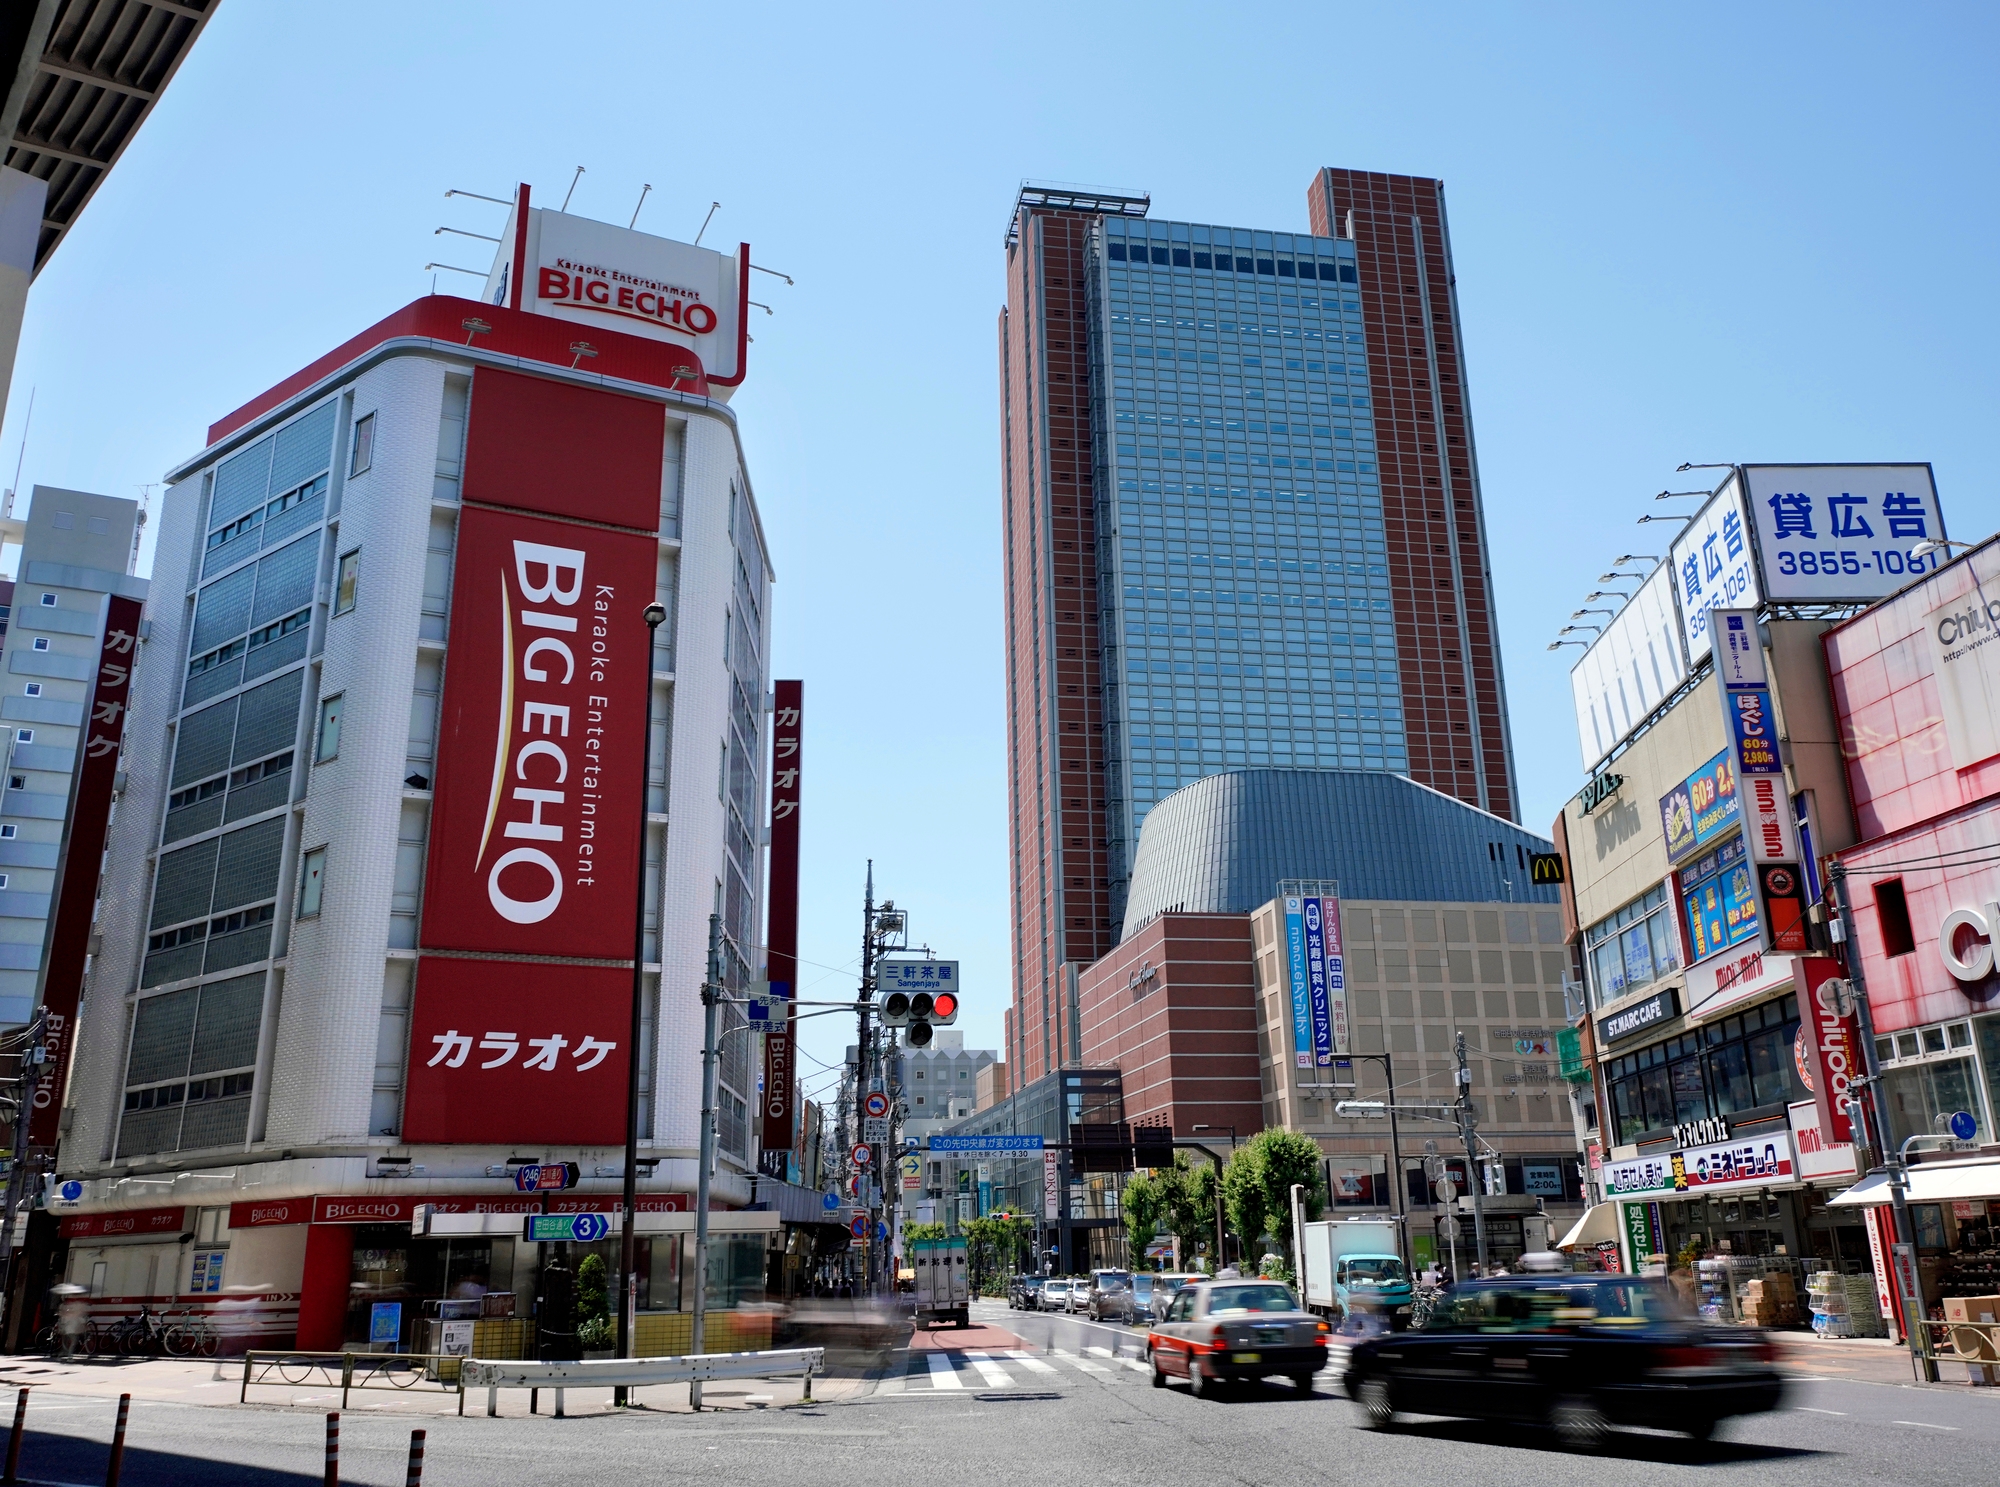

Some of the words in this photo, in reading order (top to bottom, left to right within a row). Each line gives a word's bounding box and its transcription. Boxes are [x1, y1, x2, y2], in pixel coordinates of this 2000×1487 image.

[557, 257, 607, 278] Karaoke
[612, 270, 700, 300] Entertainment
[538, 267, 609, 304] BIG
[617, 286, 717, 334] ECHO
[1768, 492, 1928, 541] 貸広告
[1682, 509, 1744, 606] 貸広告
[1778, 550, 1938, 575] 3855-1081
[512, 539, 585, 685] BIG
[588, 584, 614, 682] Karaoke
[87, 629, 135, 758] カラオケ
[1737, 694, 1764, 736] ほぐし
[1743, 738, 1769, 749] 60分
[1743, 751, 1774, 765] 2,980円
[773, 706, 800, 820] カラオケ
[576, 695, 608, 888] Entertainment
[1692, 778, 1714, 811] 60分
[1754, 779, 1776, 813] mini
[487, 702, 570, 924] ECHO
[1761, 823, 1784, 858] mini
[1308, 907, 1319, 928] 眼科
[1325, 901, 1340, 953] ほけんの窓口
[885, 965, 951, 979] 三軒茶屋
[897, 979, 940, 988] Sangenjaya
[1291, 927, 1308, 1035] コンタクトのアイシティ
[1715, 963, 1737, 994] mini
[1740, 949, 1764, 980] mini
[759, 996, 780, 1006] 先発
[1308, 935, 1328, 1044] 光寿眼科クリニック
[750, 1021, 786, 1032] 時差式
[1334, 1000, 1347, 1046] 無料相談
[1607, 1006, 1639, 1037] ST.MARC
[1638, 998, 1662, 1028] CAFÉ
[426, 1029, 618, 1072] カラオケ
[770, 1038, 785, 1069] BIG
[33, 1054, 57, 1109] EHO
[769, 1074, 784, 1118] ECHO
[934, 1137, 1039, 1149] この先中央線が変わります
[1672, 1115, 1729, 1148] サンマルクカフェ
[1798, 1126, 1820, 1155] mini
[856, 1150, 868, 1158] 40
[1711, 1144, 1779, 1179] ミネドラッグ
[524, 1168, 539, 1182] 246
[1046, 1164, 1056, 1207] TOKYU
[1530, 1171, 1556, 1180] 営業時間
[1613, 1162, 1665, 1192] 処方せん受付
[1671, 1156, 1688, 1189] 薬
[151, 1216, 172, 1225] カラオケ
[251, 1209, 266, 1223] BIG
[266, 1207, 288, 1221] ECHO
[326, 1203, 356, 1219] BIG
[358, 1202, 400, 1217] ECHO
[430, 1202, 461, 1213] ラオケ
[475, 1202, 502, 1213] BIG
[504, 1202, 543, 1213] ECHO
[556, 1202, 600, 1212] カラオケ
[613, 1202, 640, 1212] BG
[640, 1202, 677, 1212] ECHO
[69, 1221, 90, 1231] カラオケ
[103, 1219, 117, 1232] BIG
[116, 1218, 135, 1231] ECHO
[535, 1219, 570, 1231] 世田谷通り
[579, 1218, 591, 1236] 3
[266, 1294, 278, 1302] IN
[375, 1328, 396, 1338] OFF
